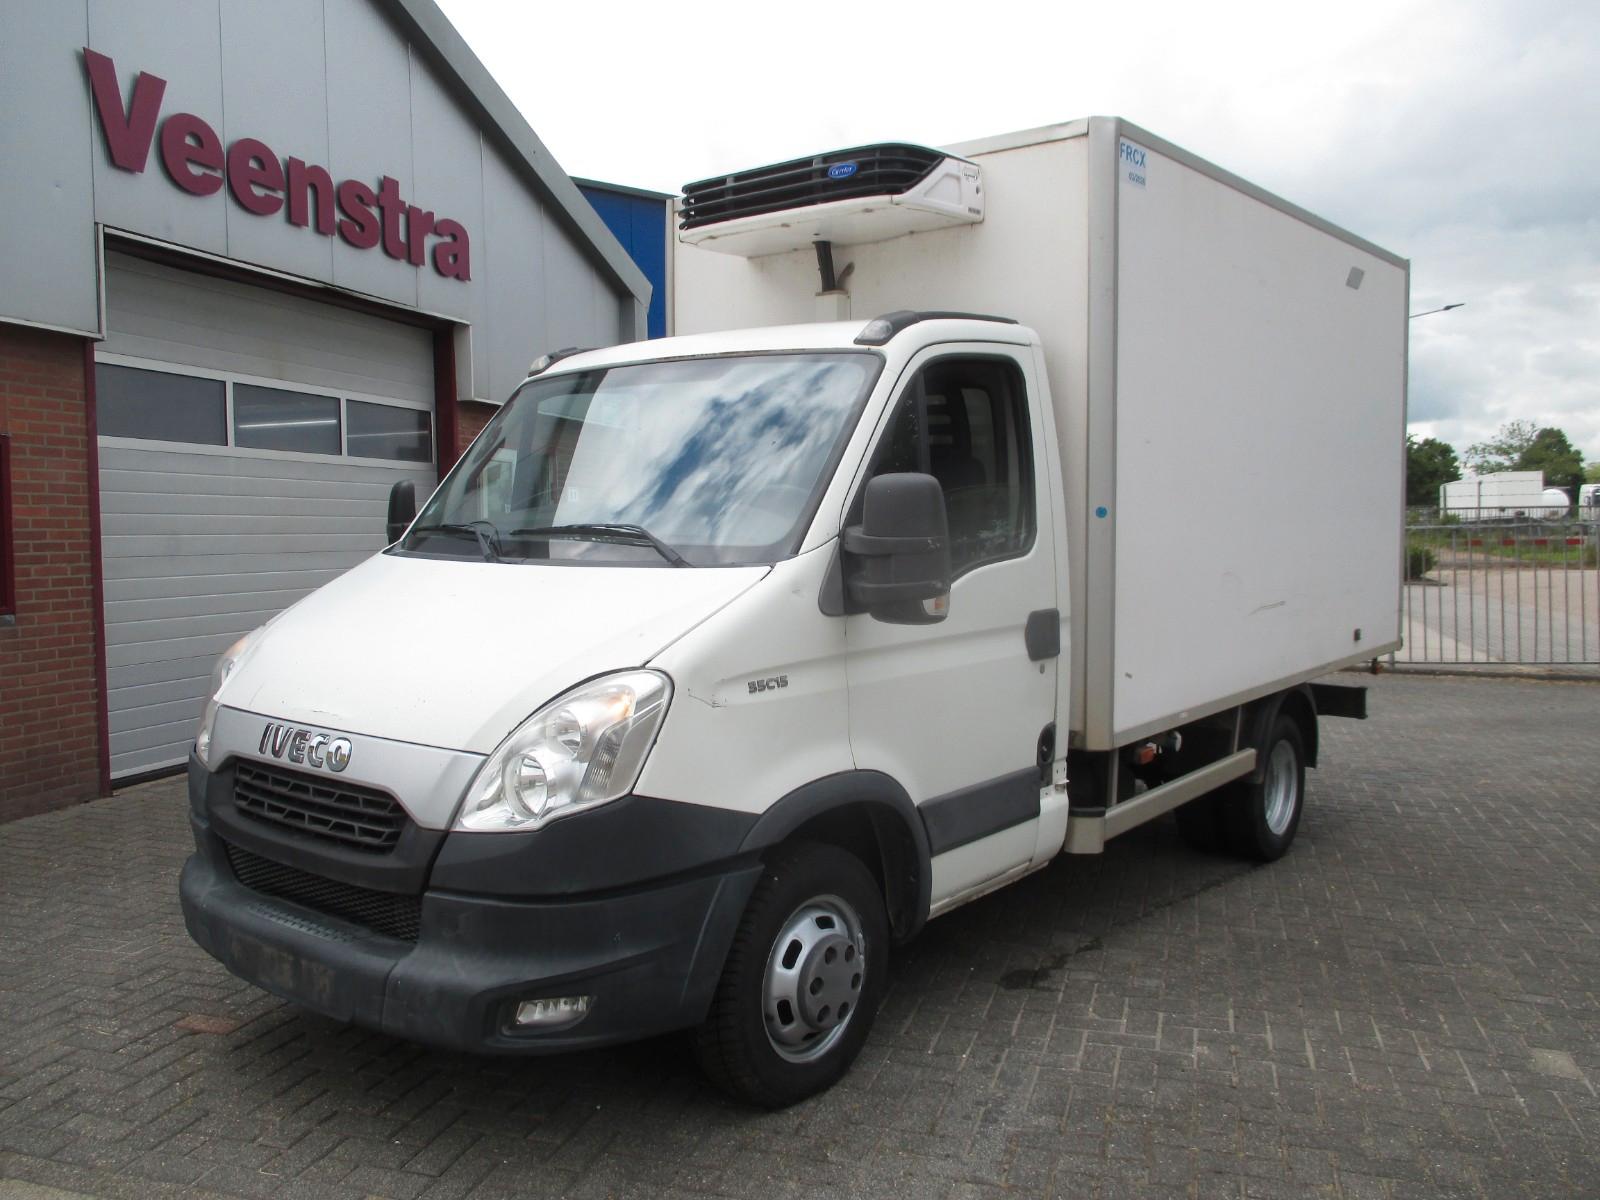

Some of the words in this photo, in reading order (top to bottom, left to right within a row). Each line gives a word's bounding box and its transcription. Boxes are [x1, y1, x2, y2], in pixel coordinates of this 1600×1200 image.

[83, 47, 471, 281] Veenstra
[1119, 142, 1146, 169] FRCX
[747, 674, 789, 694] 35C15
[258, 722, 353, 773] IVECO
